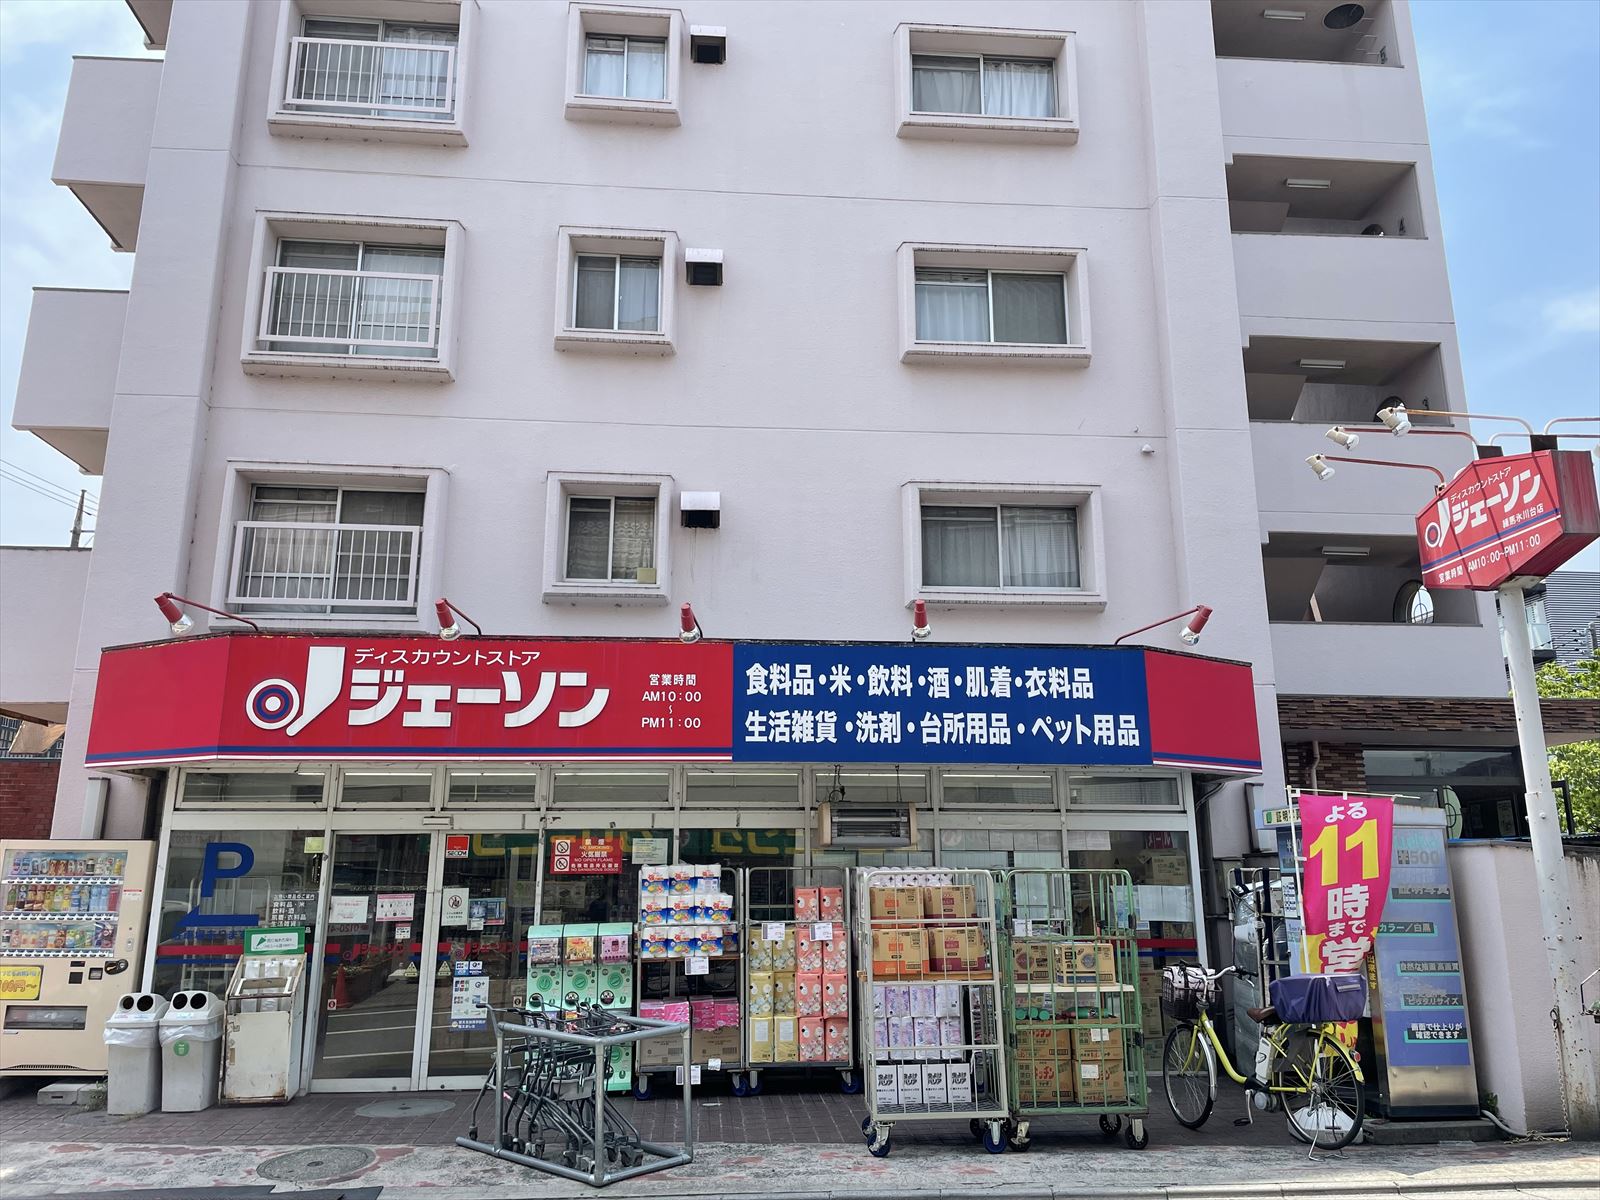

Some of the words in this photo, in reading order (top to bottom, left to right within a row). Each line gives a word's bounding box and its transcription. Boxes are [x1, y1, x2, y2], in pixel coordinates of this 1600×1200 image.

[1450, 466, 1512, 503] ディスカウントストア
[1451, 469, 1541, 535] ジェーソン
[1438, 564, 1464, 584] 営業時間
[354, 647, 541, 666] ディスカウントストア
[648, 673, 698, 687] 営業時間
[745, 662, 1094, 699] 食料品・米・飲料・酒・肌着・衣料品
[347, 669, 611, 728] ジェーソン
[641, 691, 702, 702] AM10:00
[641, 717, 702, 729] PM11:00
[744, 709, 1140, 746] 生活雑貨・洗剤・台所用品・ペット用品
[1324, 801, 1368, 823] よる
[1309, 818, 1380, 887] 11
[201, 842, 255, 898] P
[1327, 883, 1369, 921] 時
[1328, 920, 1367, 938] まで
[1415, 1031, 1460, 1039] 確認できます
